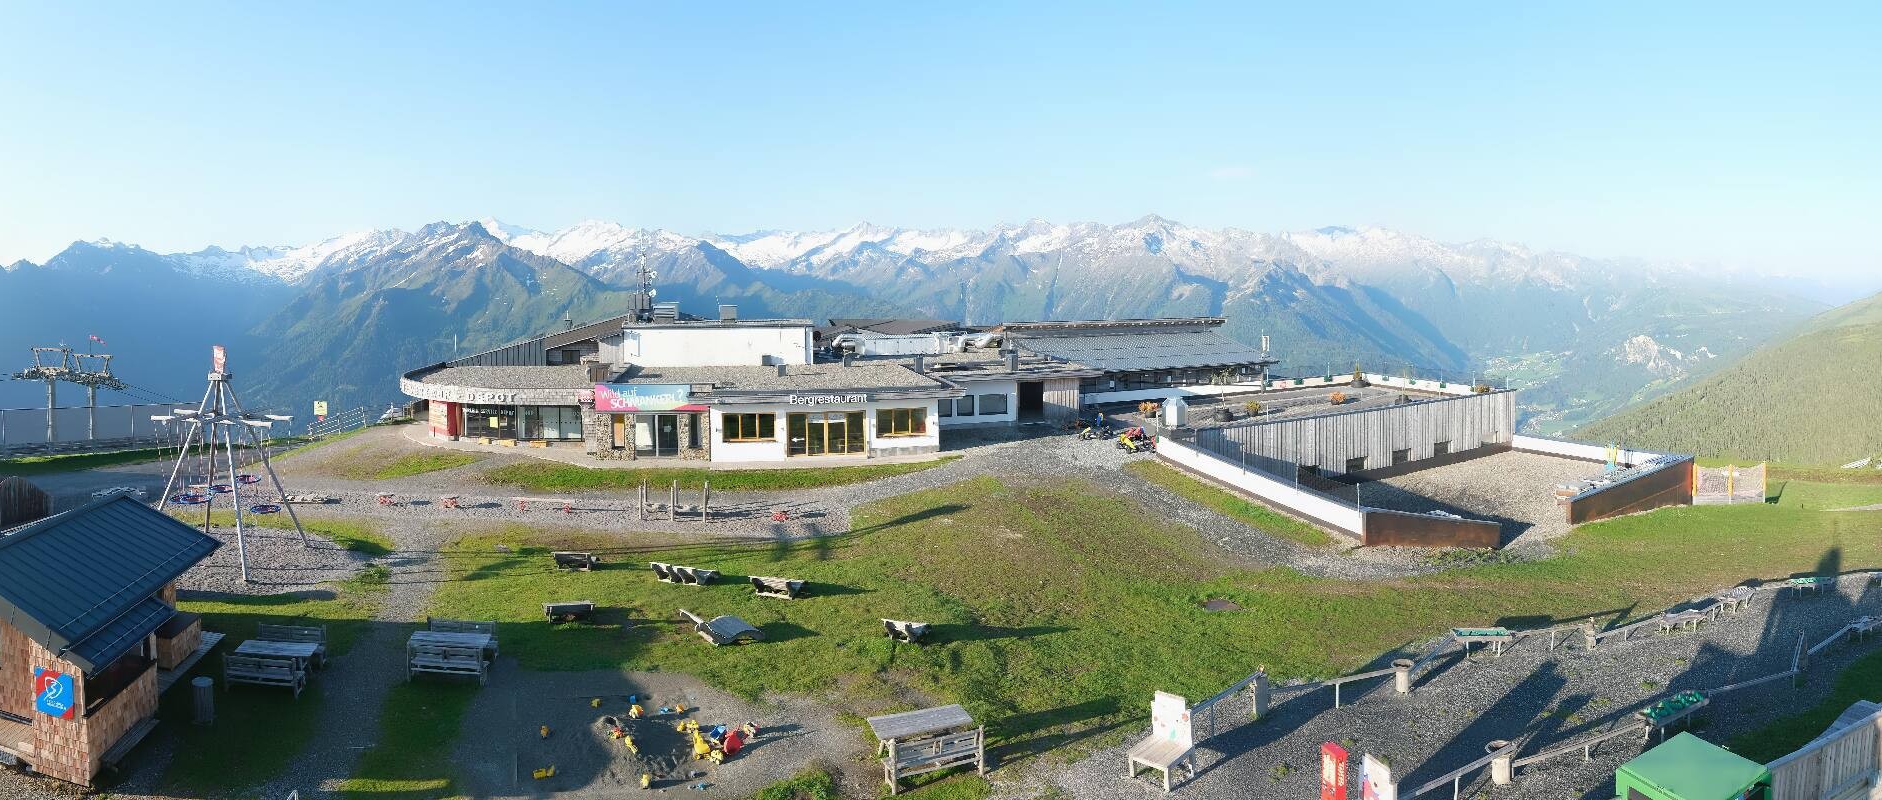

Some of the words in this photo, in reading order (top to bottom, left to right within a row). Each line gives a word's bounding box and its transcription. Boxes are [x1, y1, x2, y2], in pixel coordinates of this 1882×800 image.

[467, 392, 516, 402] DEPOT
[600, 388, 620, 400] Wild
[623, 386, 637, 397] auf
[789, 393, 868, 406] Bergrestaurant
